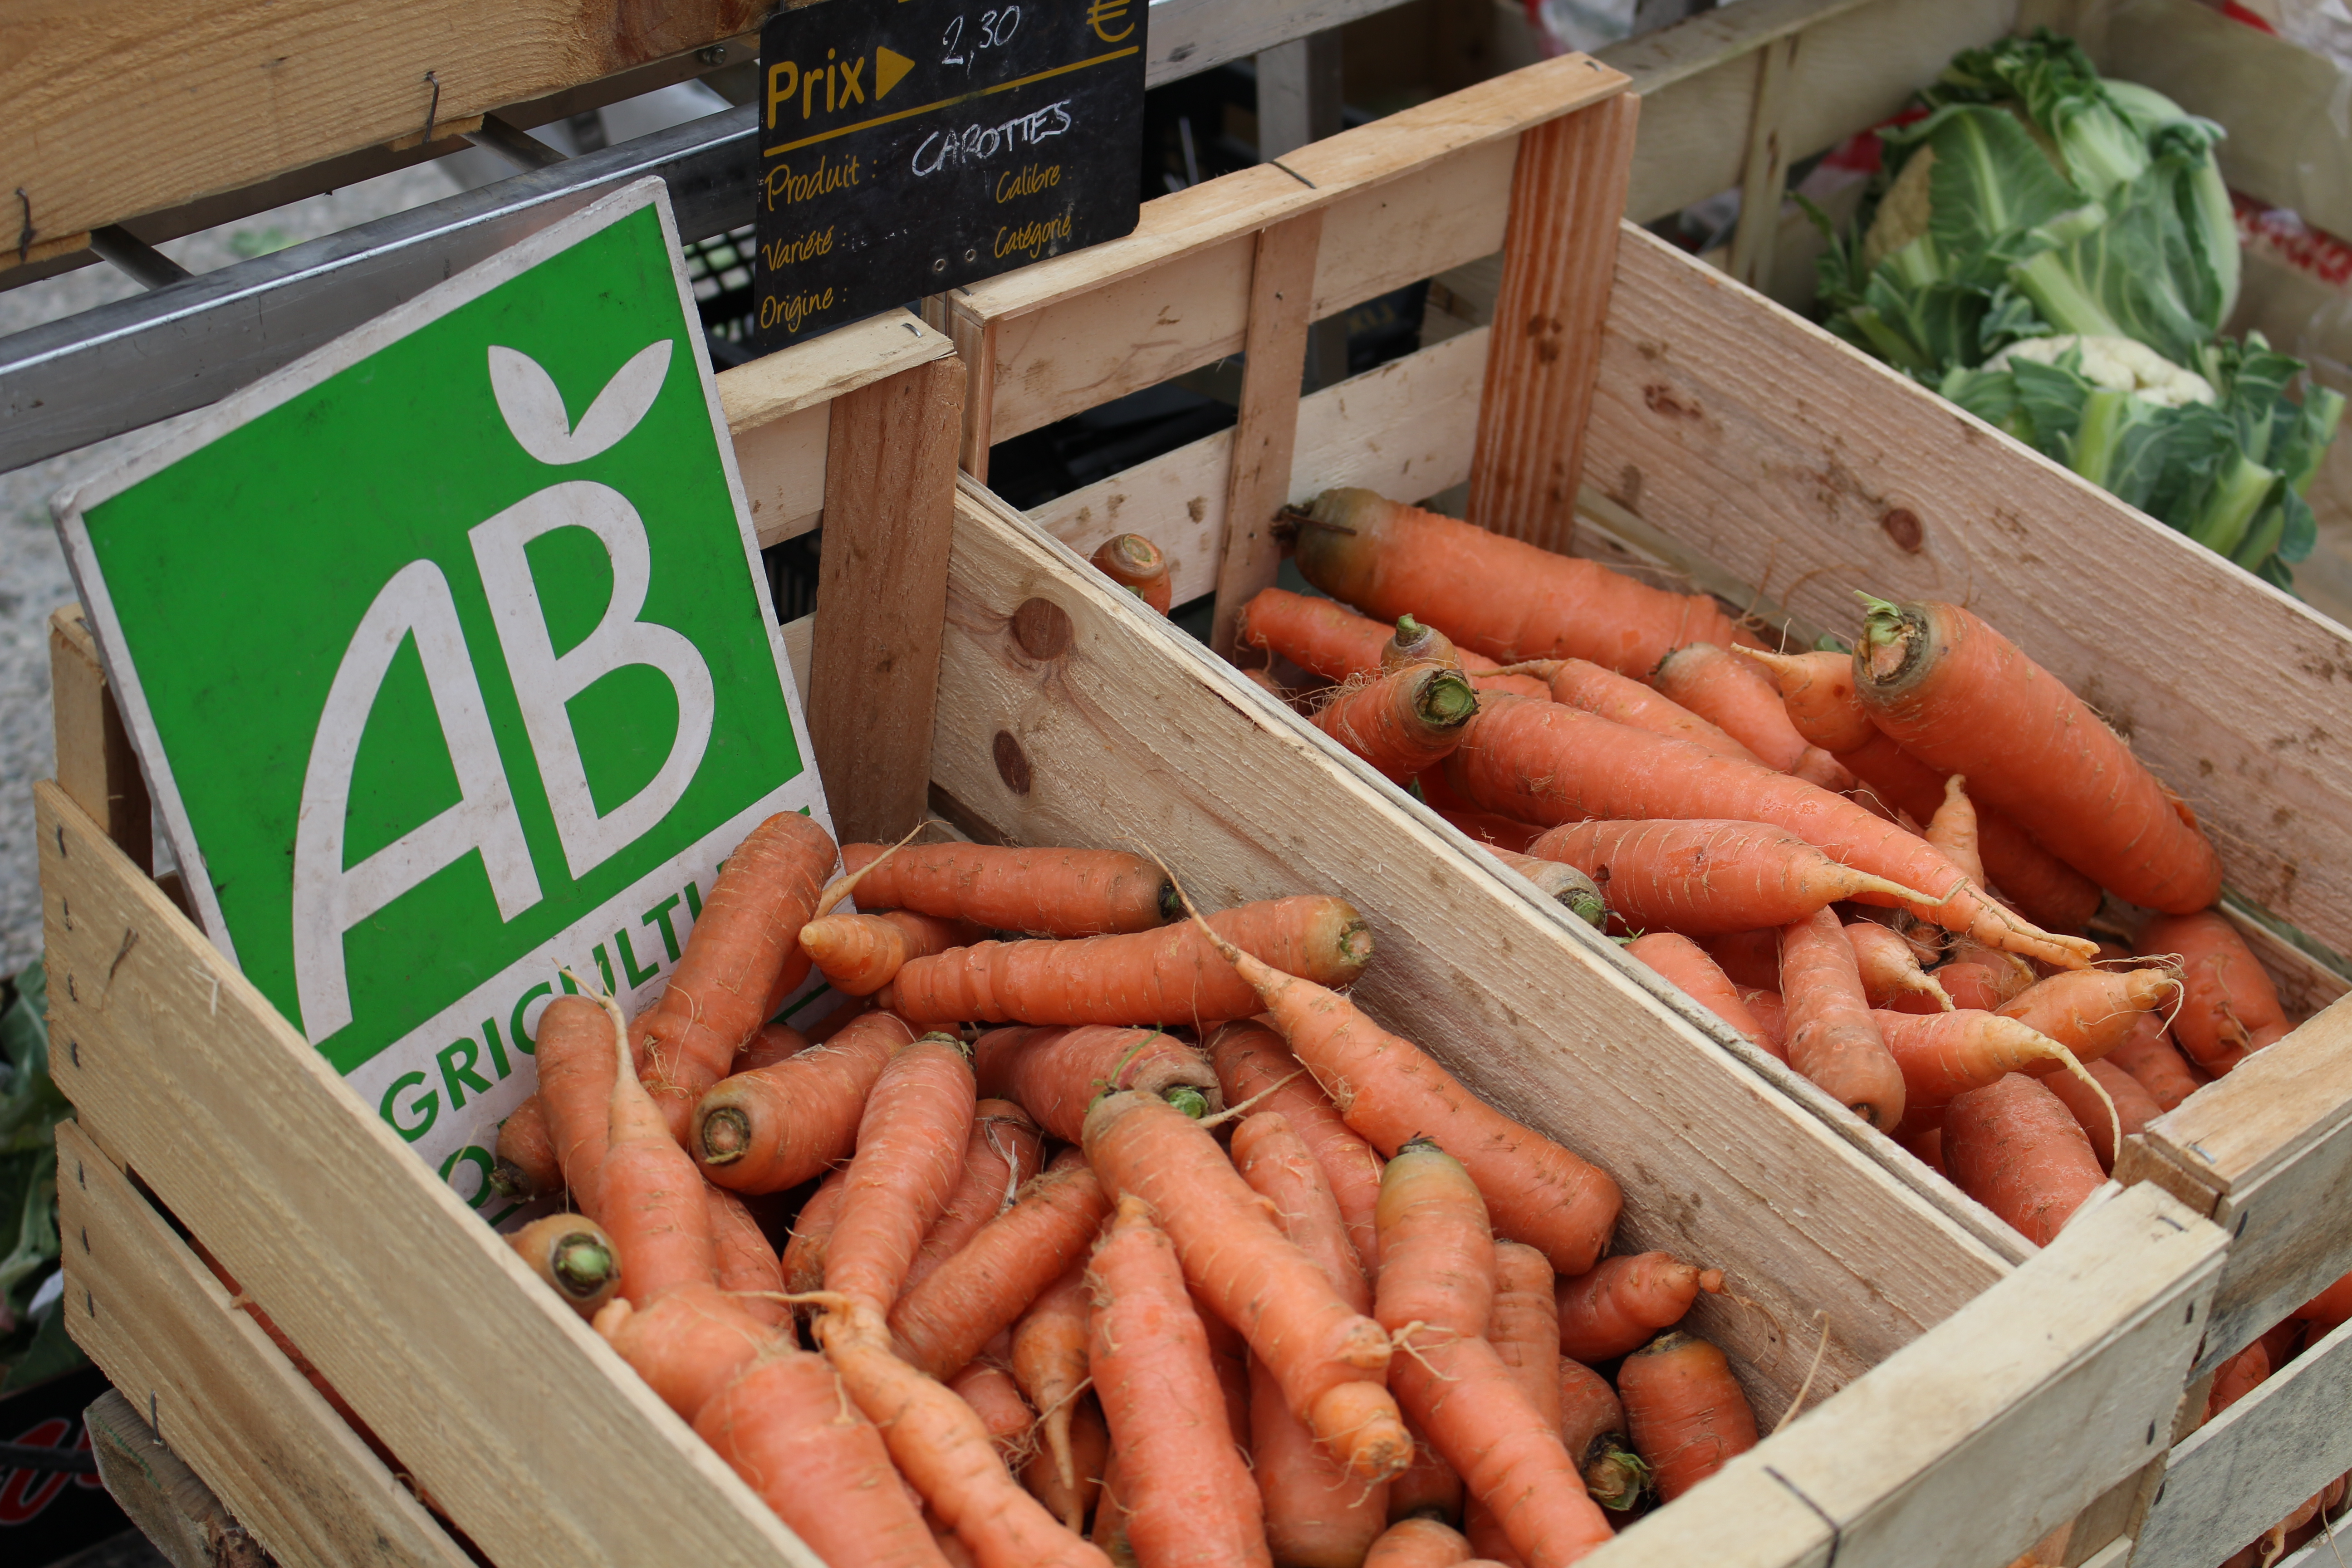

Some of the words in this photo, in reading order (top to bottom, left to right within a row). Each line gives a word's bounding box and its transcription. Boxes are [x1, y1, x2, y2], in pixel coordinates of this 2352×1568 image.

[768, 48, 864, 129] Prix
[942, 5, 1020, 80] 2,30
[765, 154, 859, 211] Produit
[912, 99, 1071, 176] CAROTTES
[996, 163, 1060, 203] Calibre
[762, 225, 834, 271] Variété
[994, 213, 1071, 259] Catégorie
[760, 287, 833, 332] Origine
[292, 480, 715, 1048] AB
